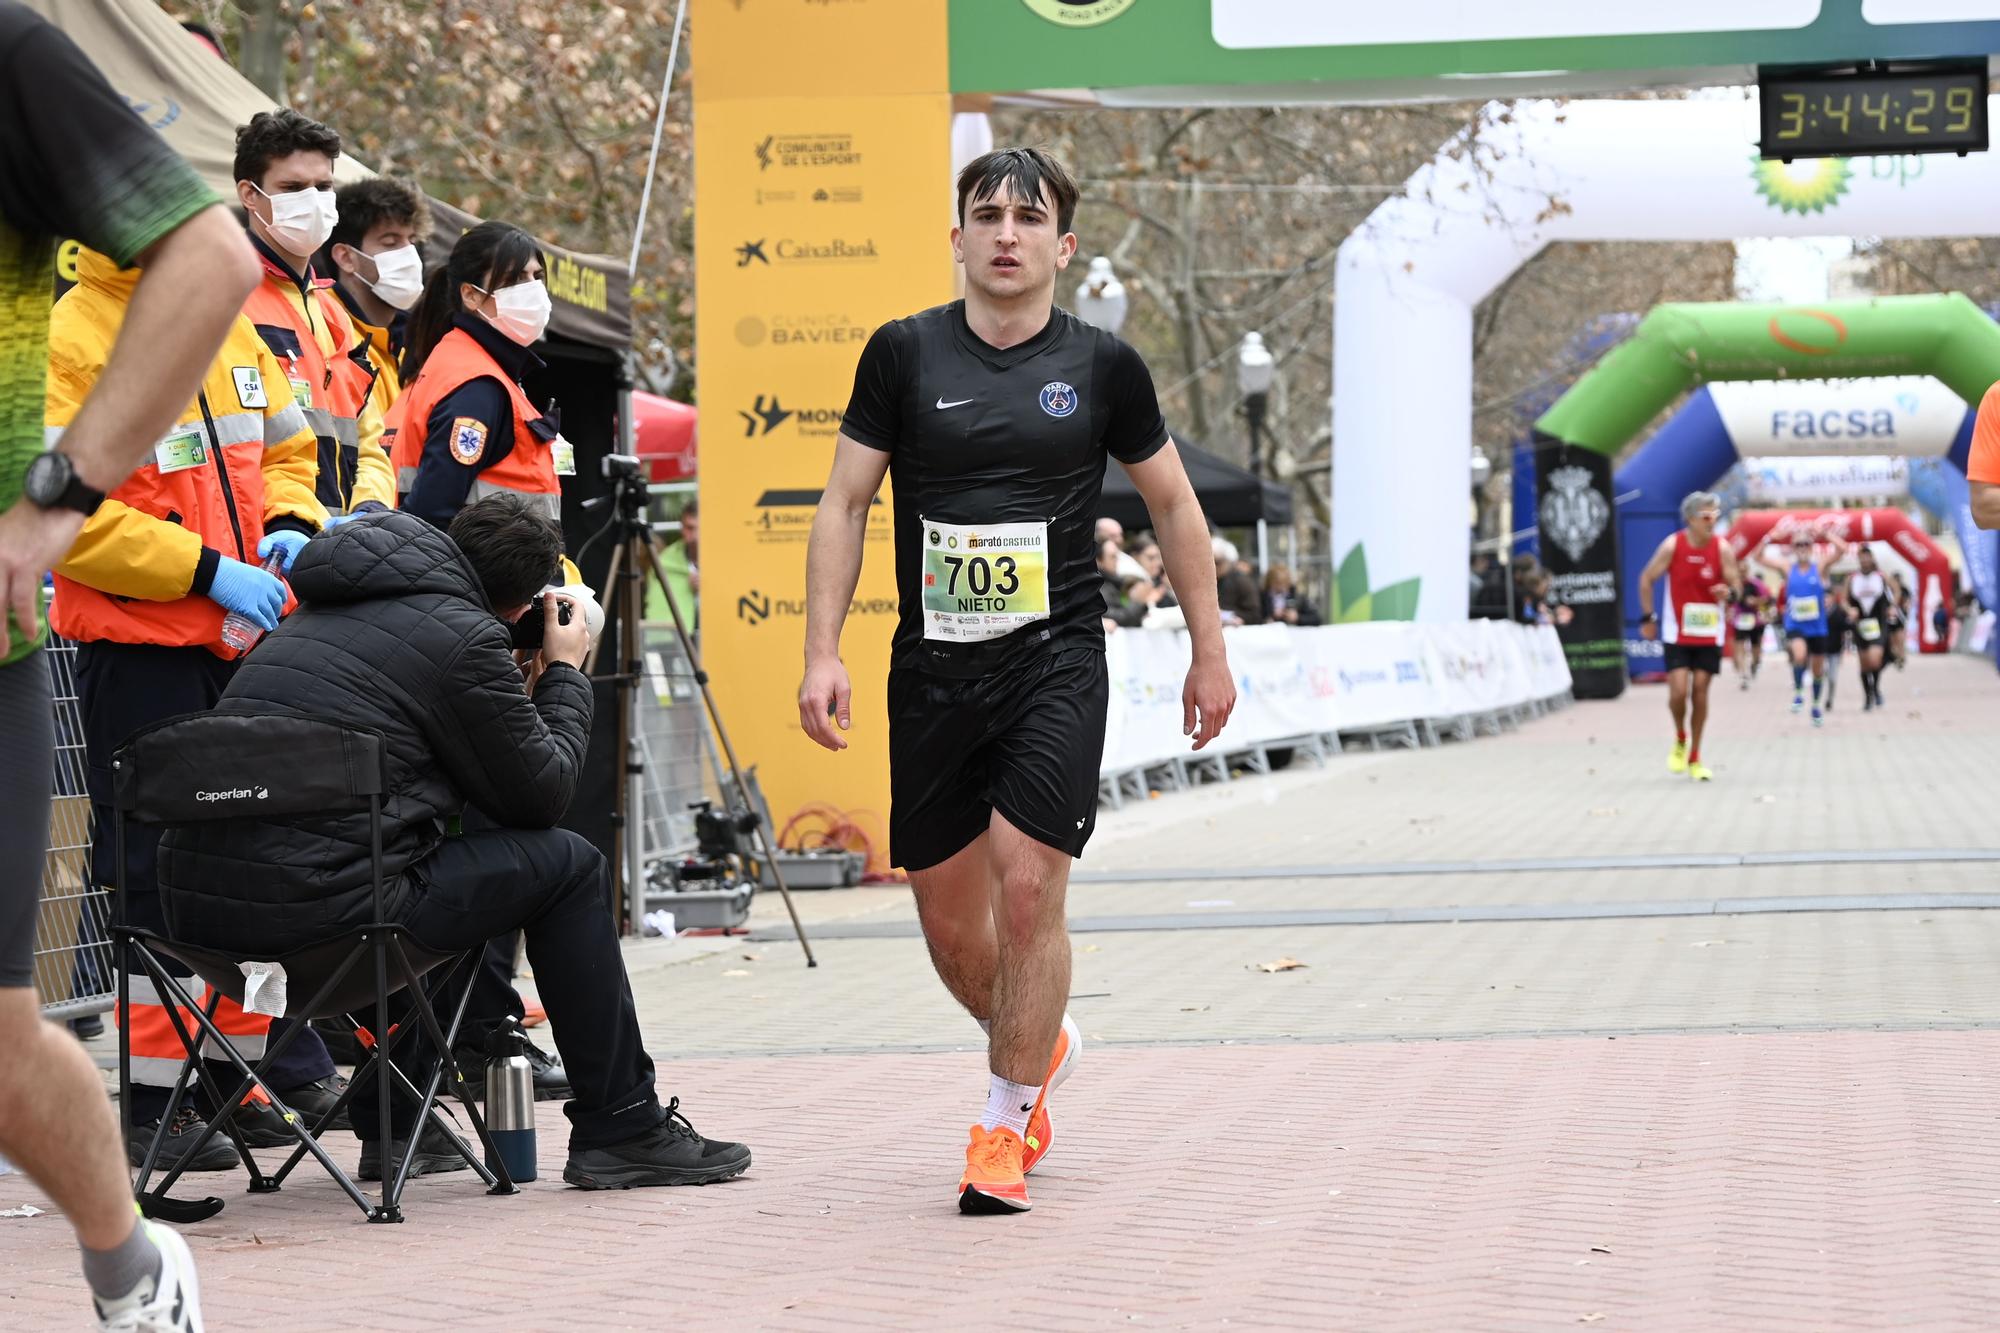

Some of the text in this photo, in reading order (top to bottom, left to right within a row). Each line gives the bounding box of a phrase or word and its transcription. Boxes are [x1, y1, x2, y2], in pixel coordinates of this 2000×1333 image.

[1778, 87, 1974, 139] 3:44:29
[776, 141, 853, 154] COMUNITAT
[781, 153, 861, 166] DE L'ESPORT
[775, 238, 878, 258] CaixaBank
[771, 327, 876, 345] BAVIER
[1045, 384, 1070, 393] PARIS
[969, 535, 1042, 549] marató CASTELLÓ
[944, 555, 1020, 597] 703
[957, 597, 1007, 612] NIETO
[196, 788, 252, 804] Caperlan
